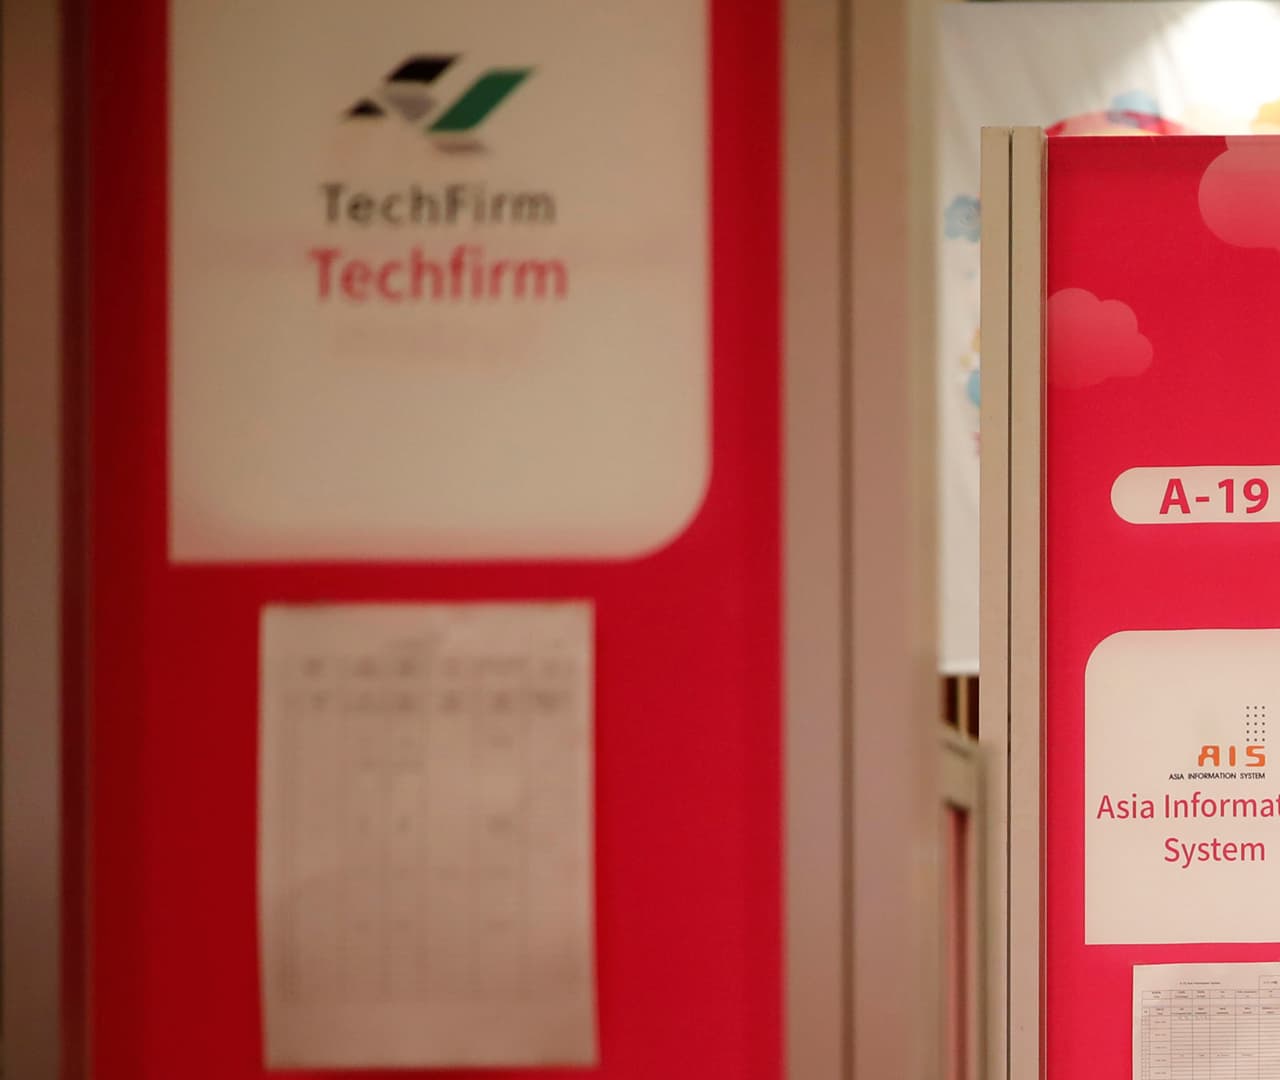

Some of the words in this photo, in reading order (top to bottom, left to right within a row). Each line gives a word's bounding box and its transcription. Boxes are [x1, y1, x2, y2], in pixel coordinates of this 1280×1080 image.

[319, 183, 557, 225] TechFirm
[308, 244, 569, 303] Techfirm
[1159, 477, 1270, 515] A-19
[1198, 745, 1266, 767] AIS
[1169, 772, 1184, 780] ASIA
[1188, 772, 1237, 780] INFORMATION
[1240, 772, 1266, 780] SYSTEM
[1097, 793, 1155, 819] Asia
[1164, 837, 1265, 869] System
